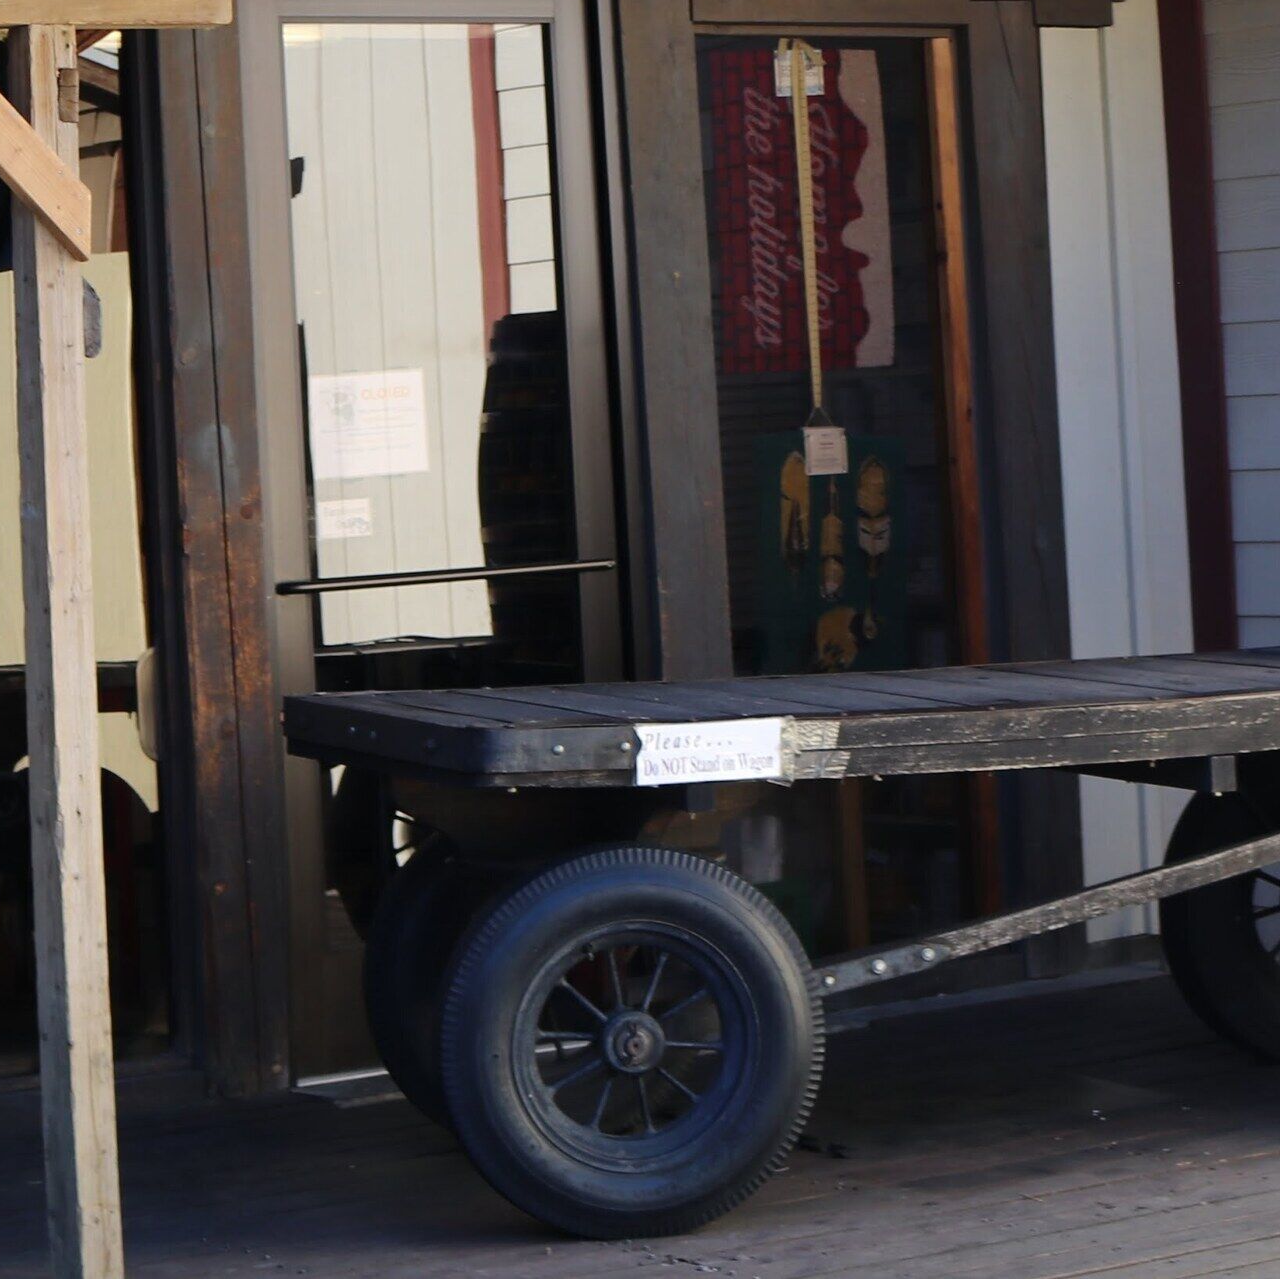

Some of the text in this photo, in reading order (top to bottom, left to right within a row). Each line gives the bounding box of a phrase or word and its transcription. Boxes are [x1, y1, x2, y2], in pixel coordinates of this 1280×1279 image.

[739, 85, 789, 350] the holidays
[643, 753, 774, 776] Do NOT Stand on Wagon
